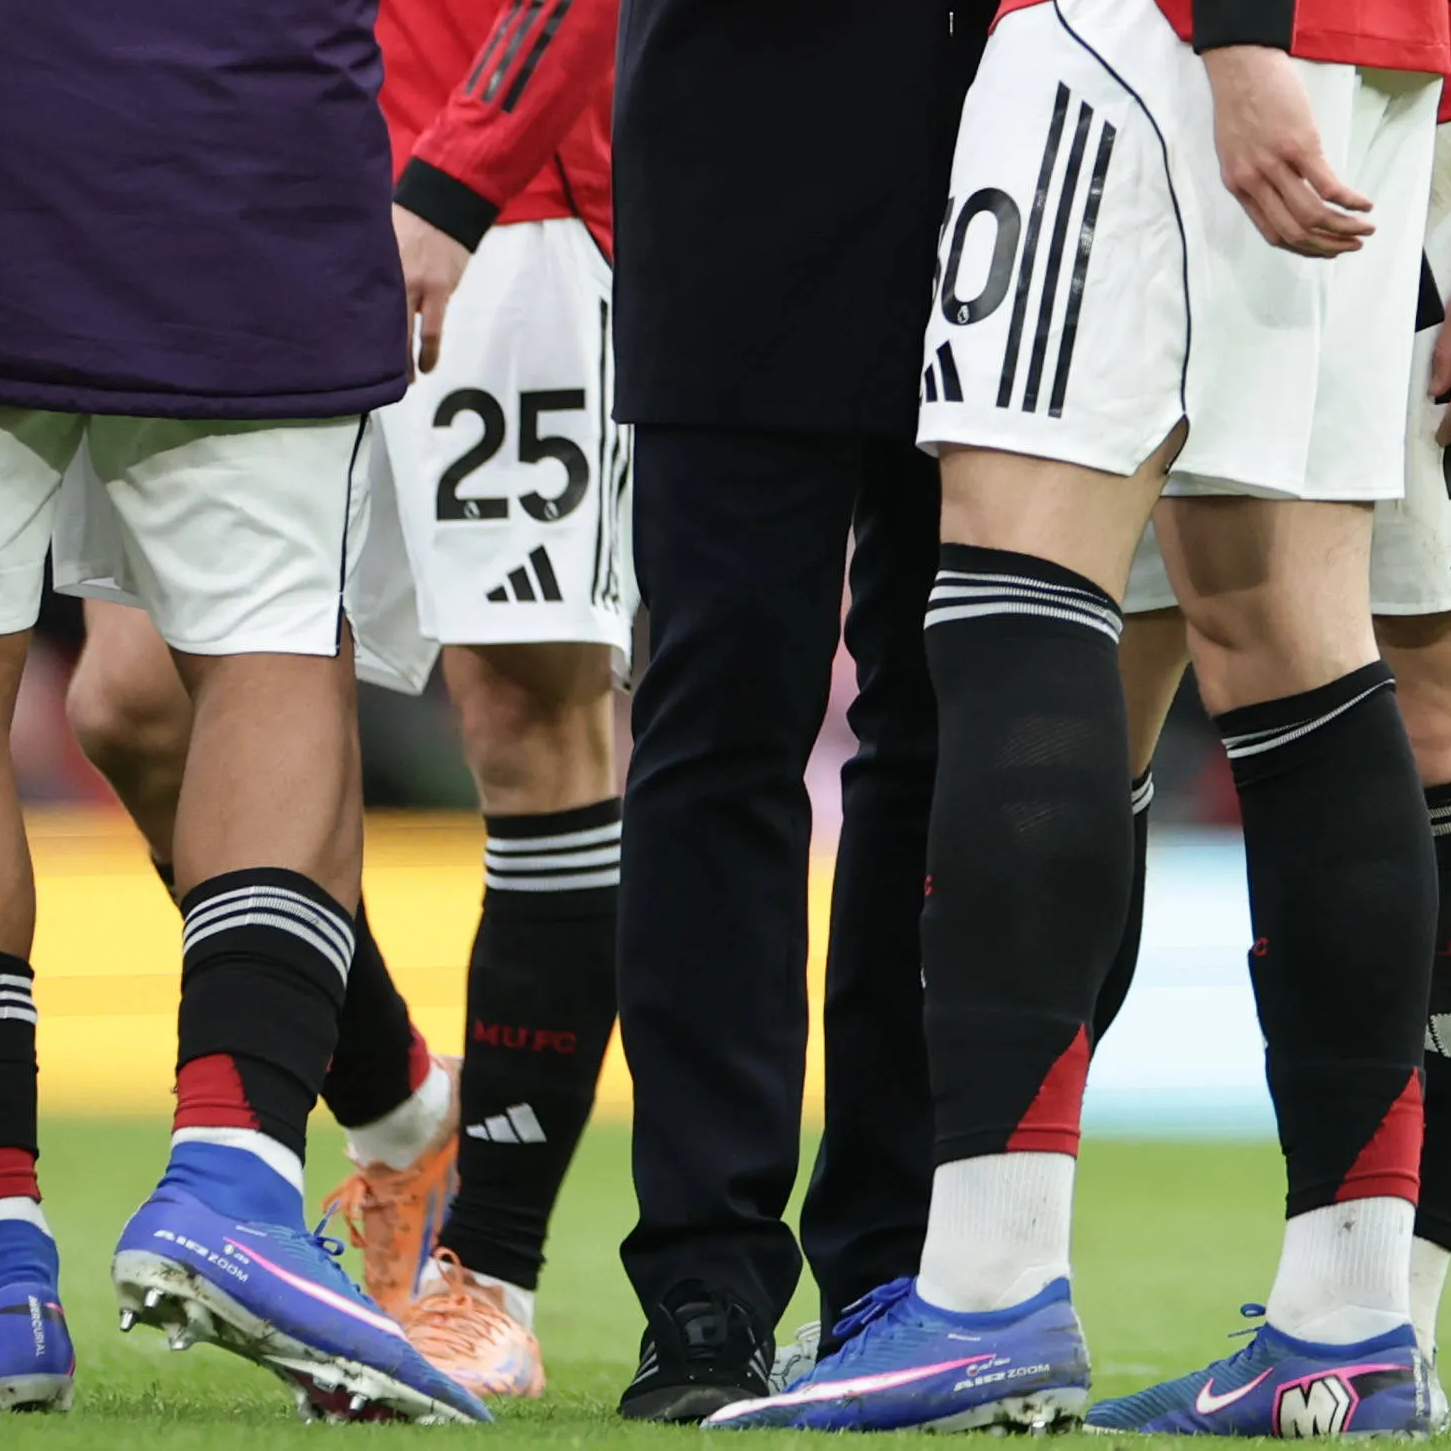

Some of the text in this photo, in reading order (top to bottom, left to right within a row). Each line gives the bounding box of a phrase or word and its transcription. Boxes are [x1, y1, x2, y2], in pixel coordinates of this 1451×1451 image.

[934, 187, 1022, 327] 0
[432, 387, 590, 523] 25
[474, 1019, 578, 1054] MUFC
[208, 1252, 249, 1283] ZOOM
[1008, 1363, 1051, 1379] ZOOM
